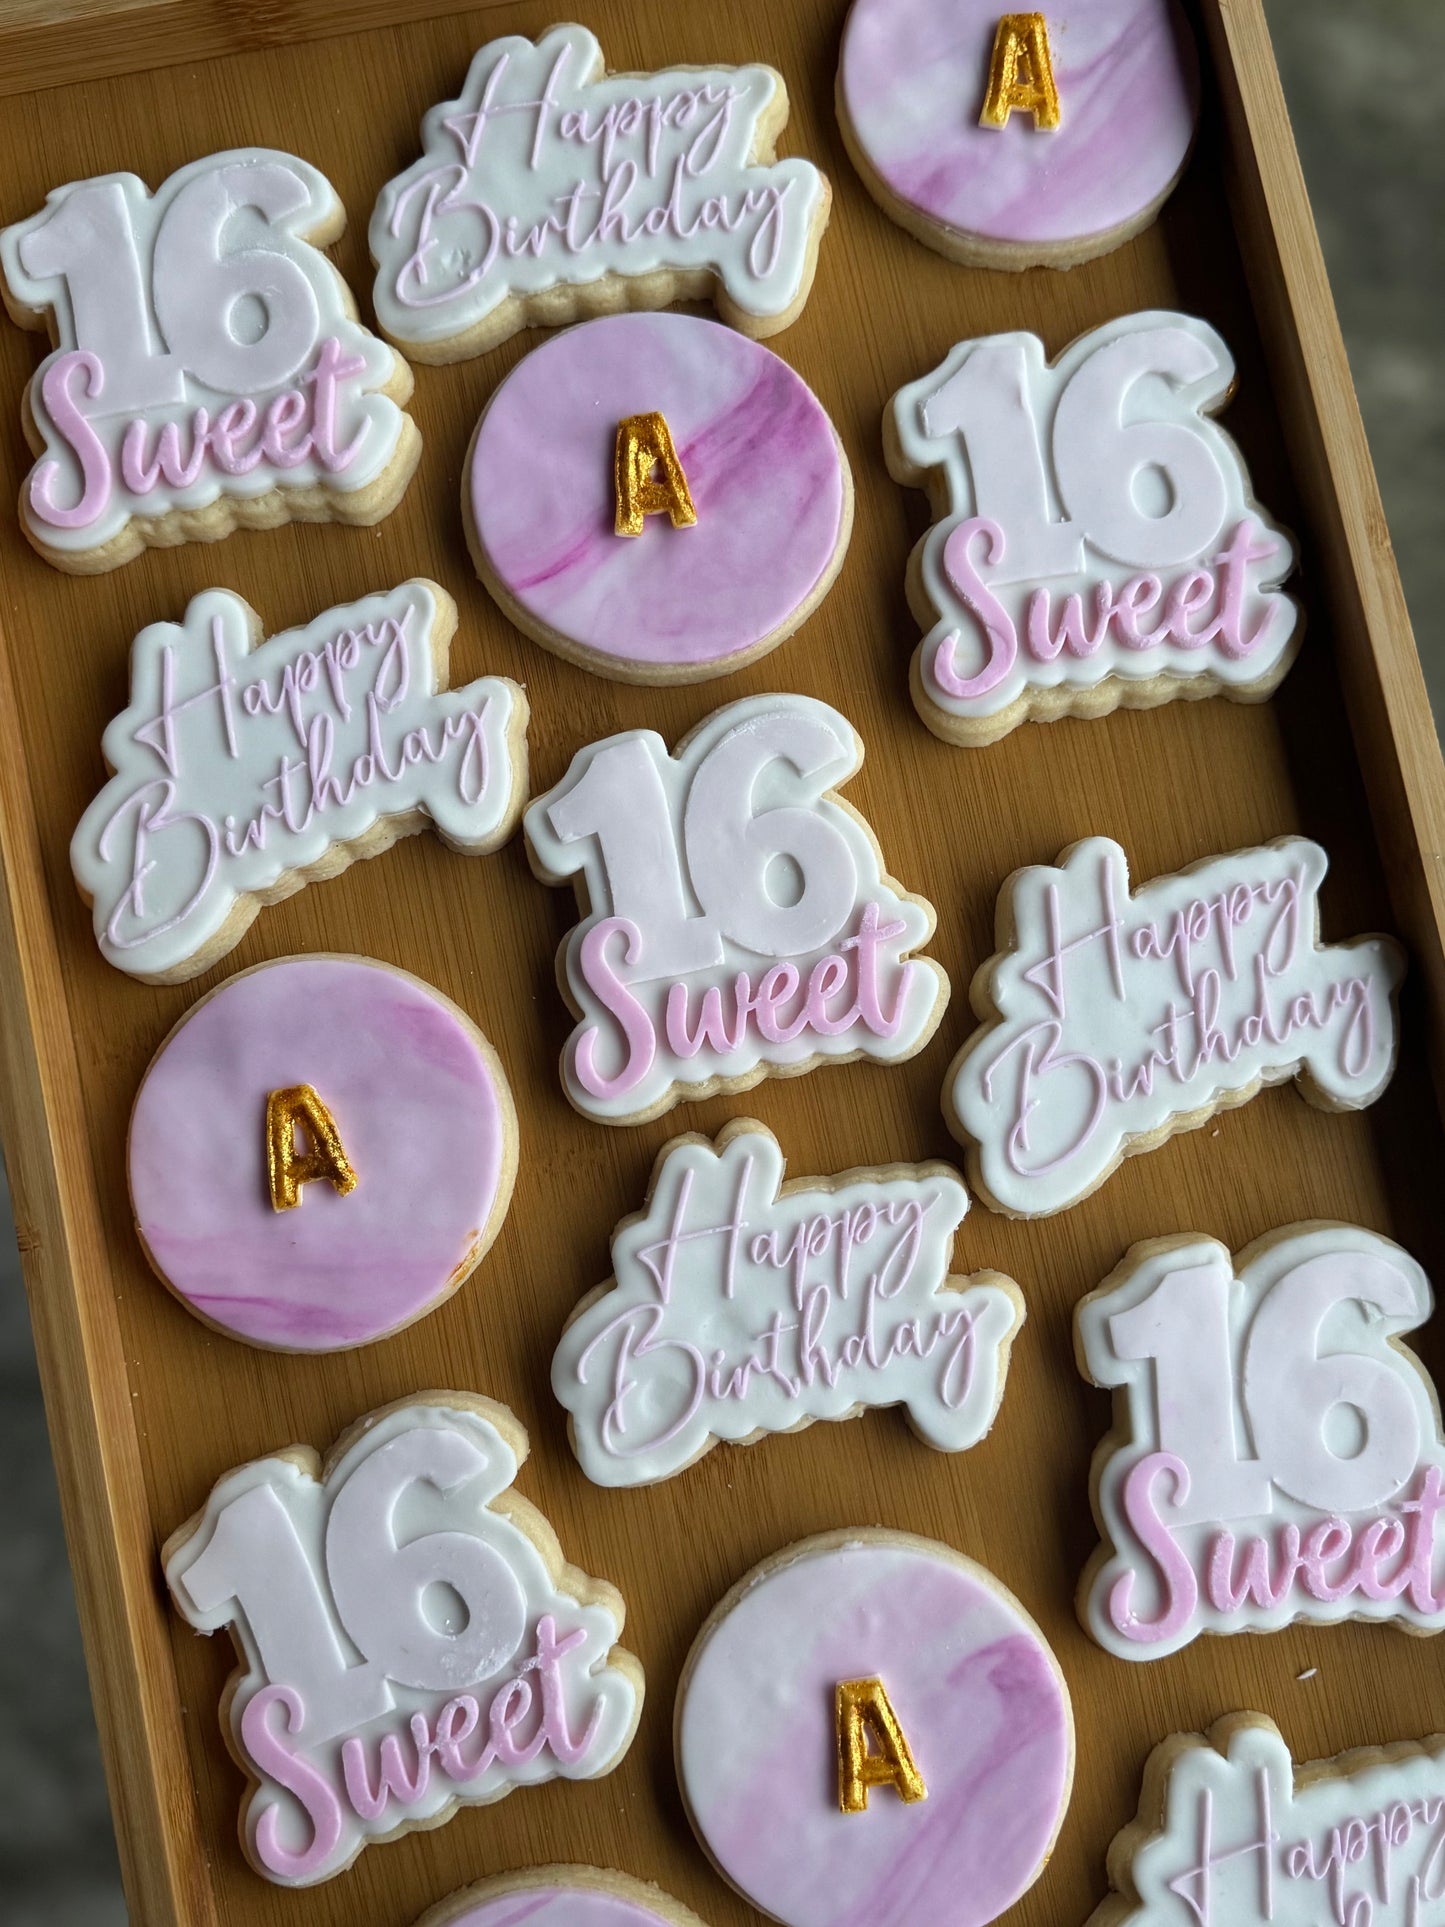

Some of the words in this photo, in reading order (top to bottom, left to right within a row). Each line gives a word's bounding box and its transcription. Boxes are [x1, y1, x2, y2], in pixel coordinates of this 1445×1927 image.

[443, 43, 751, 180] Happy
[979, 12, 1062, 131] A
[19, 160, 322, 418] 16
[392, 155, 794, 307] Birthday
[30, 337, 372, 529] Sweet
[613, 411, 699, 538] A
[920, 328, 1227, 583] 16
[134, 604, 415, 777] Happy
[934, 518, 1280, 697] Sweet
[99, 690, 493, 950] Birthday
[546, 711, 858, 985] 16
[575, 902, 914, 1100] Sweet
[1024, 855, 1307, 1019] Happy
[265, 1083, 358, 1214] A
[984, 953, 1375, 1177] Birthday
[638, 1155, 942, 1310] Happy
[578, 1274, 990, 1457] Birthday
[1109, 1250, 1422, 1526] 16
[182, 1427, 527, 1743] 16
[1109, 1450, 1445, 1643] Sweet
[241, 1613, 604, 1877] Sweet
[835, 1674, 928, 1814] A
